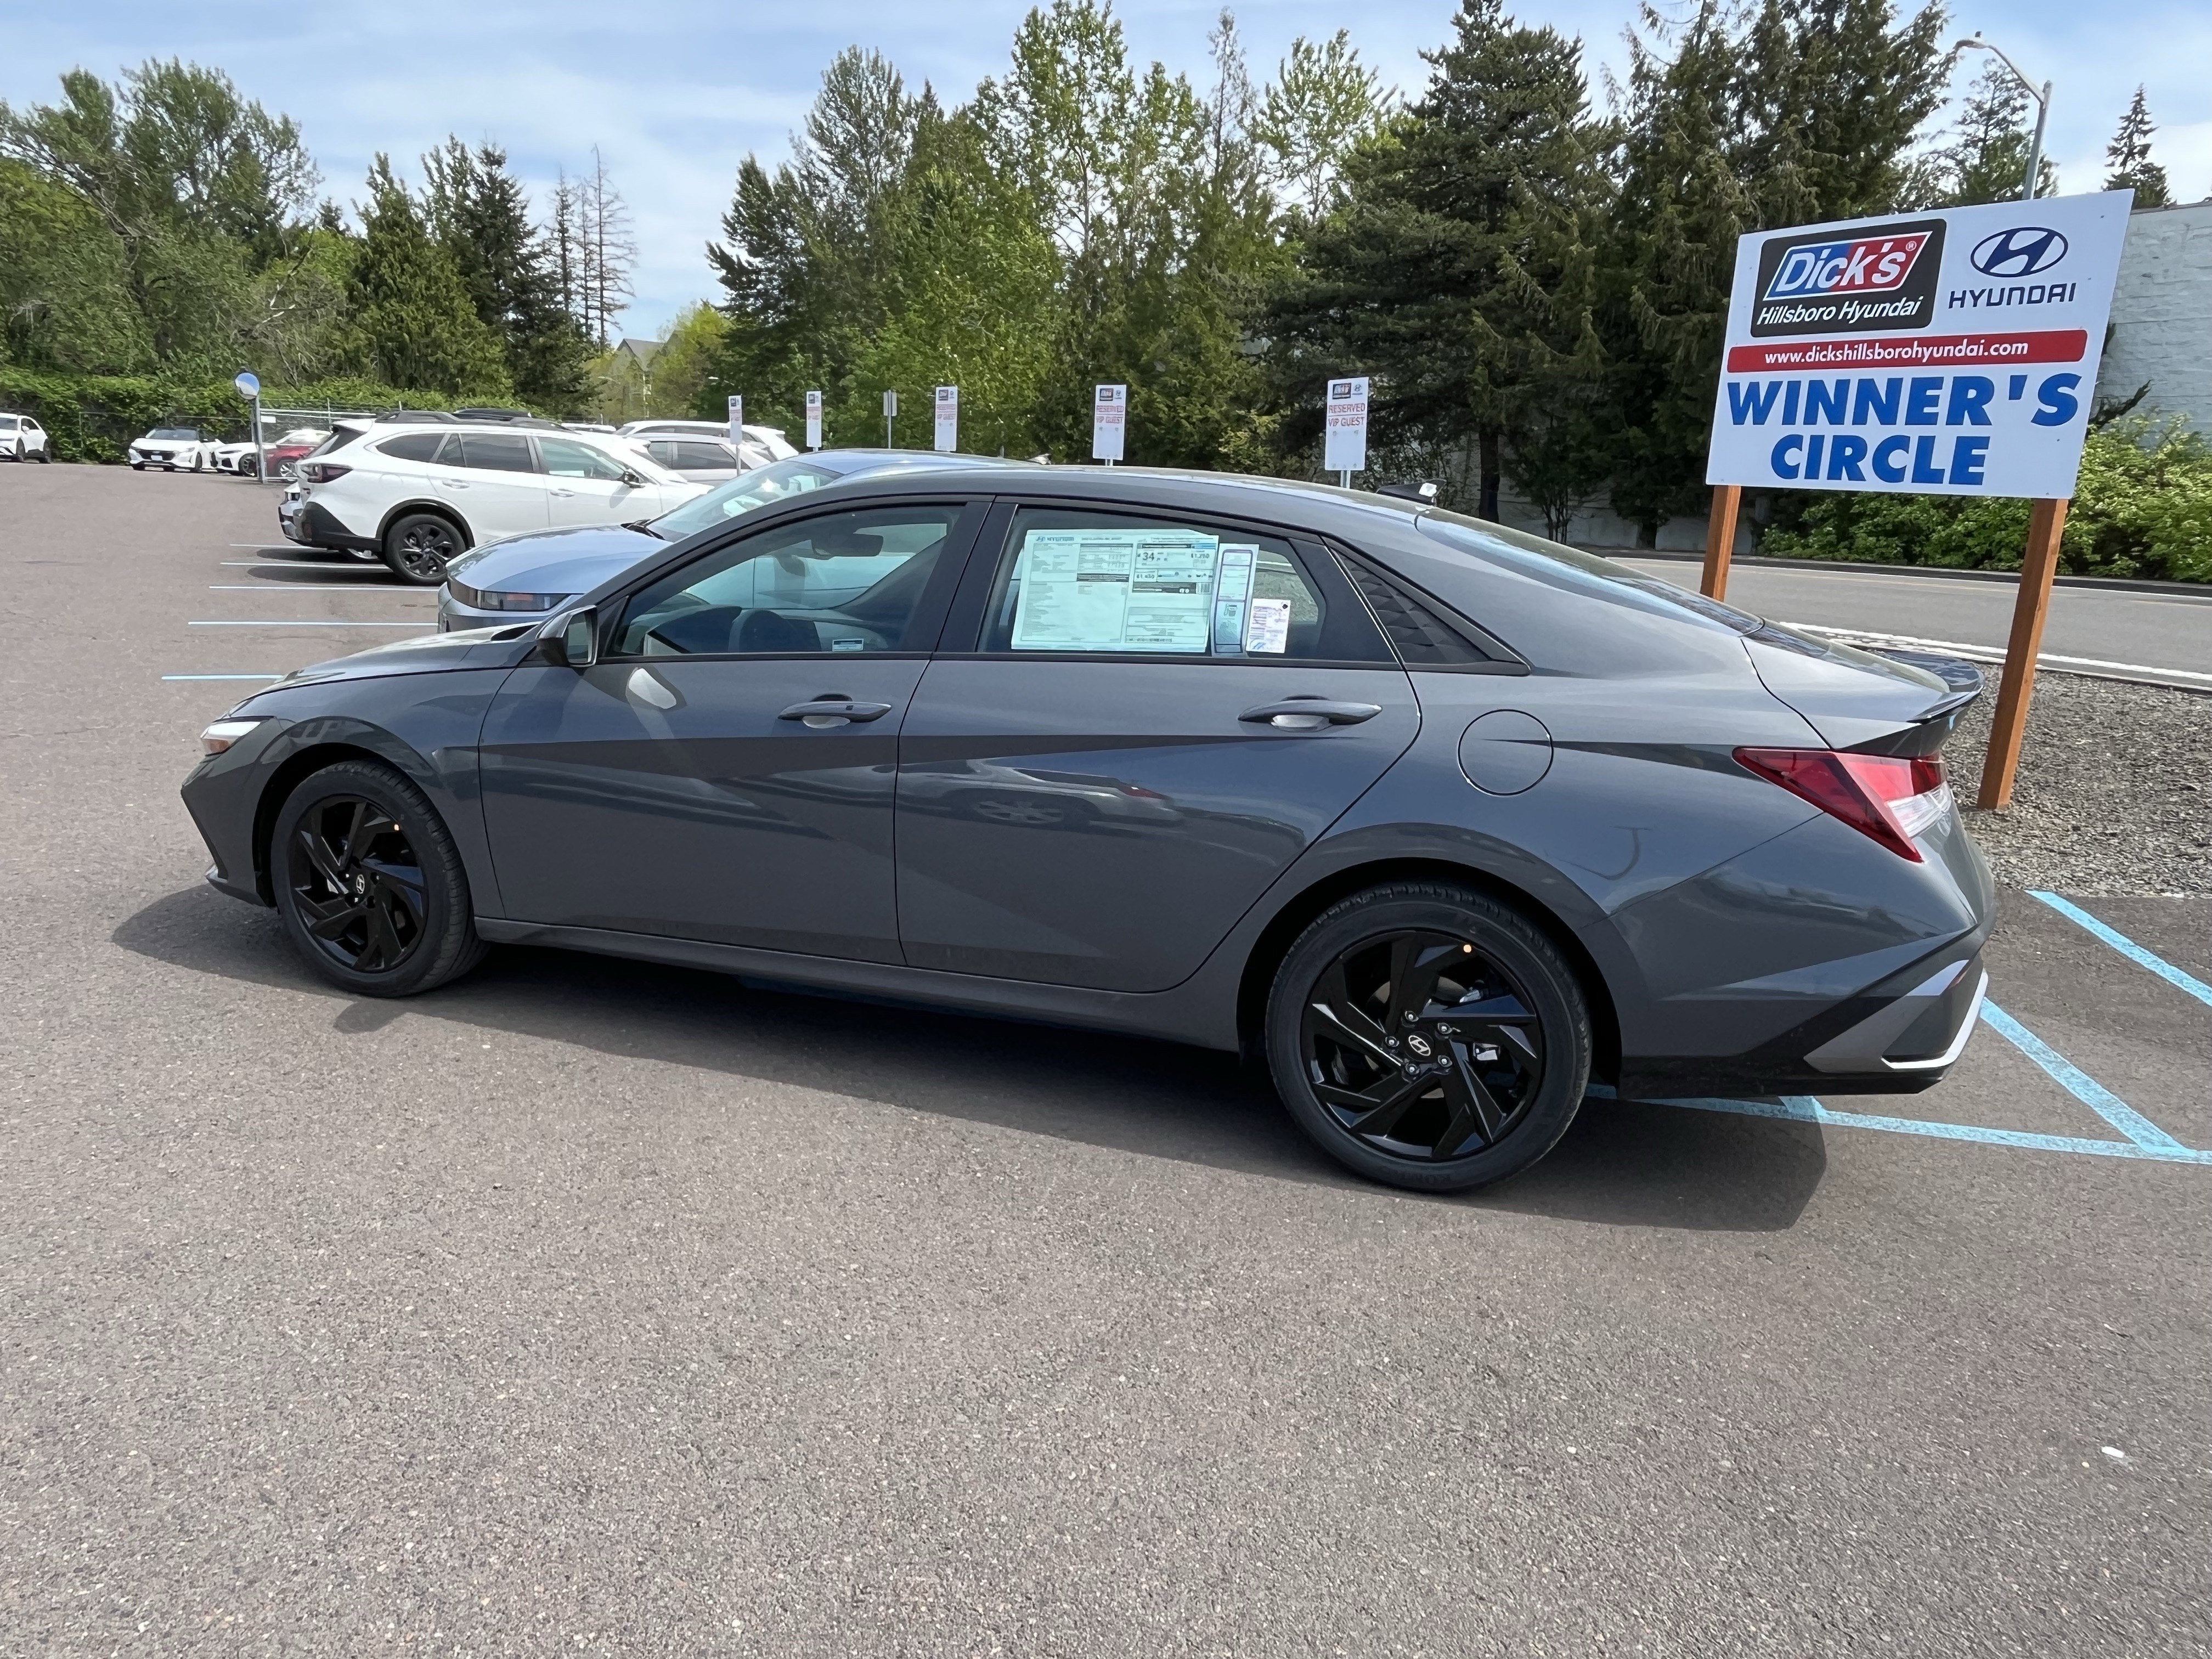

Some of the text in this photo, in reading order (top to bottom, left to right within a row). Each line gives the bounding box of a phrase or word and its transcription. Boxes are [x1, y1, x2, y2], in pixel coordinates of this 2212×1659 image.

[1948, 282, 2076, 309] HYUNDAI
[1756, 296, 1924, 325] Hillsboro Hyundai
[1765, 338, 2028, 364] www.dickshillsborohyundai.com
[1329, 403, 1365, 414] RESERVED
[1727, 373, 2083, 427] WINNER'S
[1341, 416, 1364, 426] GUEST
[1770, 434, 1991, 486] CIRCLE
